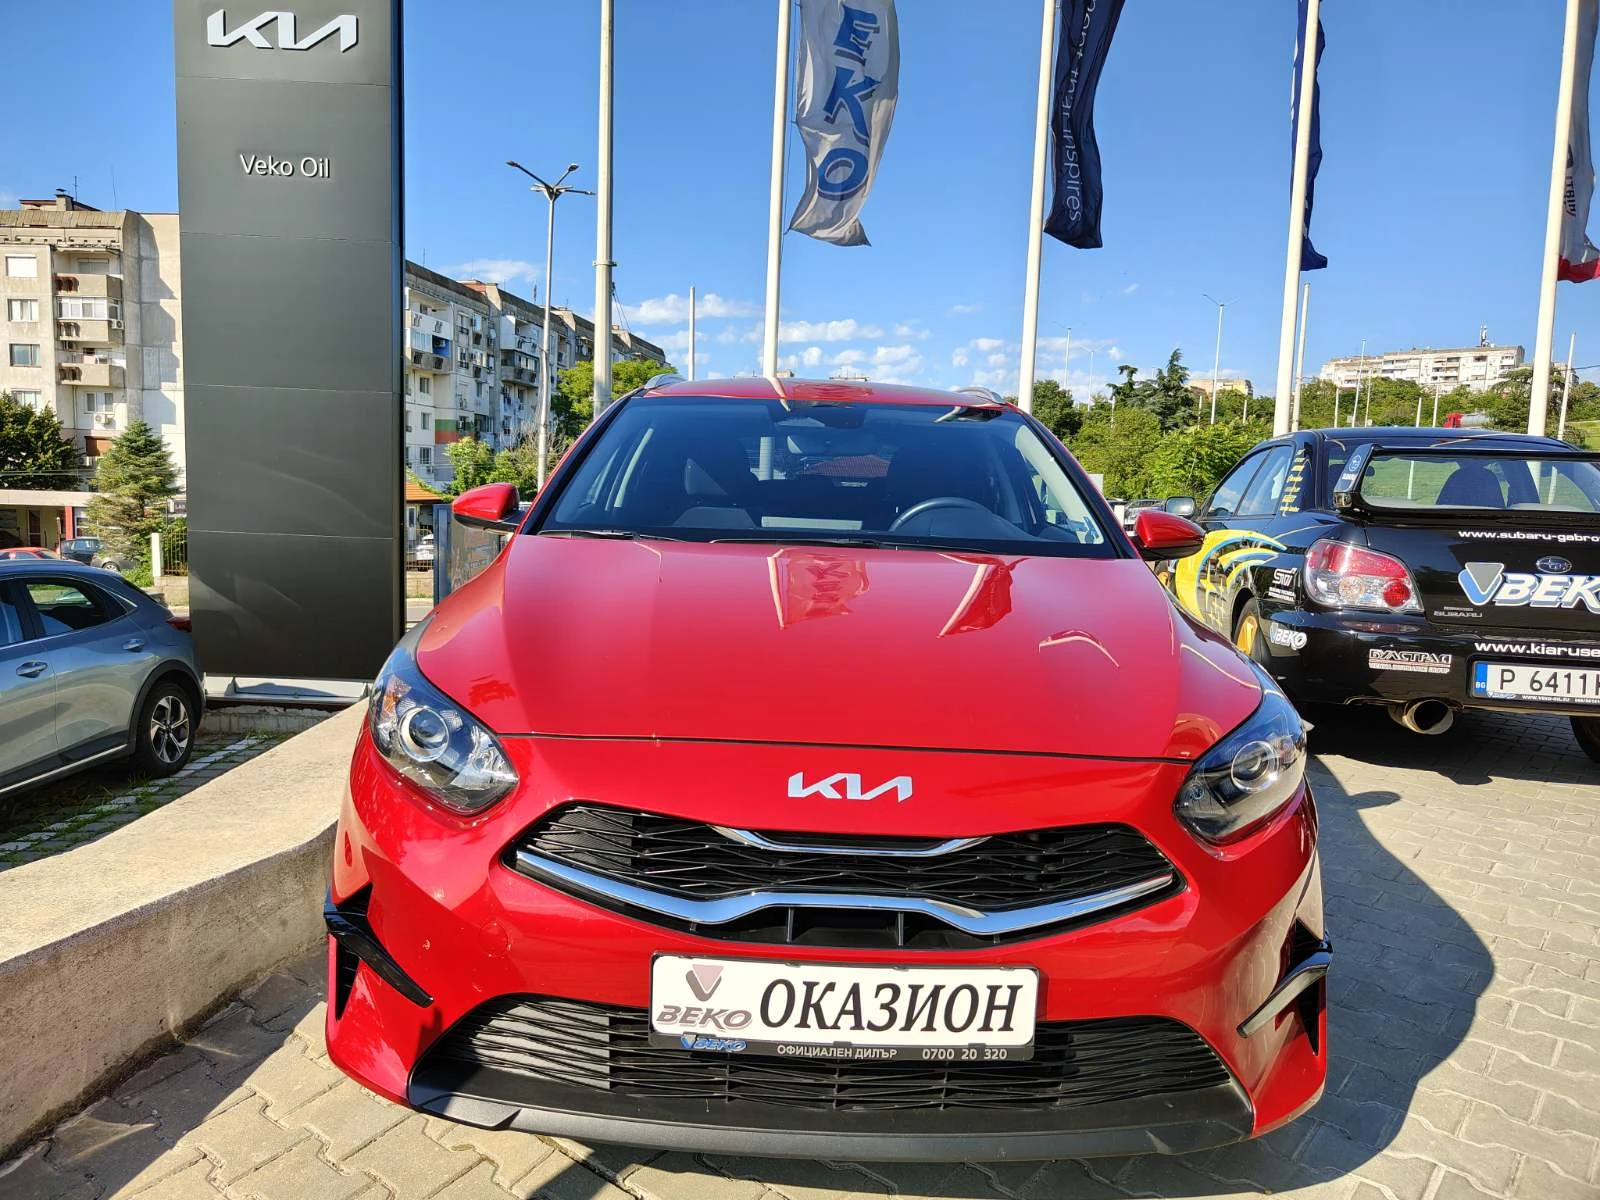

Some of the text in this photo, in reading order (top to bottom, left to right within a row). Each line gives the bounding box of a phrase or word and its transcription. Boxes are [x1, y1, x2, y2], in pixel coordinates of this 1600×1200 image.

[207, 9, 358, 53] KIA
[240, 154, 331, 178] Veko Oil
[1063, 129, 1082, 222] inspires
[1458, 530, 1600, 543] www.subaru-gabro
[1433, 610, 1483, 618] SUBARU
[1475, 681, 1486, 689] BG
[1499, 668, 1516, 690] P
[787, 771, 913, 803] KIA
[760, 978, 1024, 1033] ОКАЗИОН
[777, 1044, 853, 1058] ОФИЦИАЛЕН
[922, 1048, 1008, 1060] 0700 20 320
